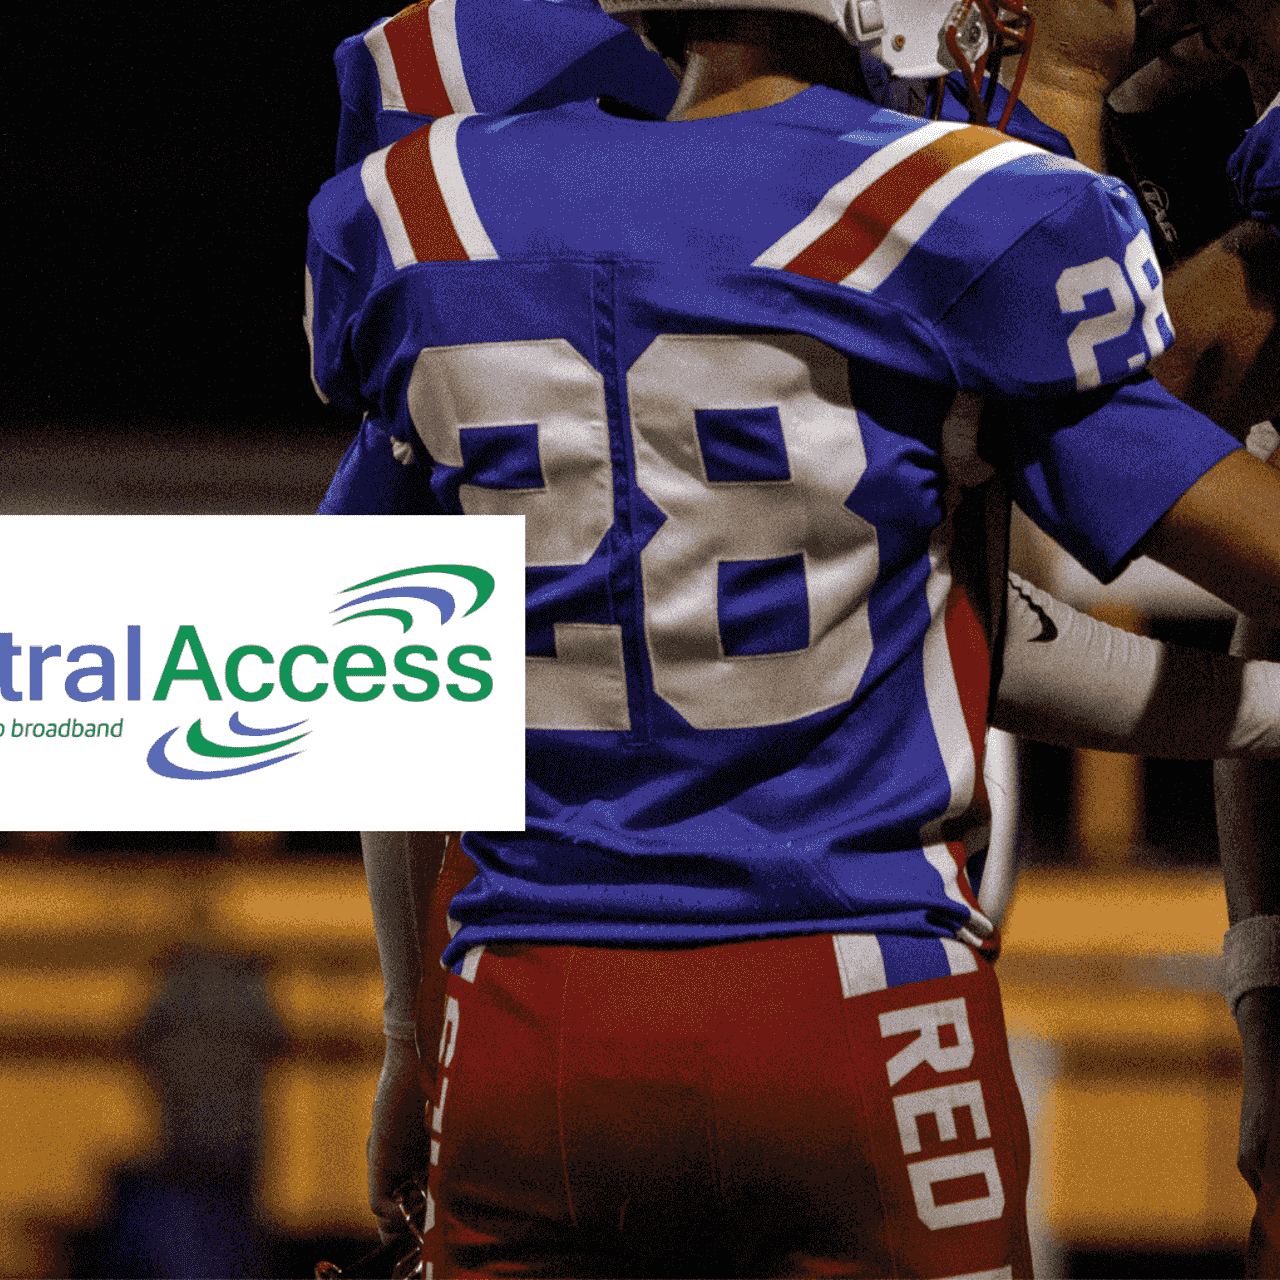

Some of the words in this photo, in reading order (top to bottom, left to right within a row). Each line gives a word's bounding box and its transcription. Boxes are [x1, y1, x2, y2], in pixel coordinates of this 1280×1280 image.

[1055, 228, 1177, 393] 28
[406, 333, 881, 731] 28
[877, 995, 1006, 1232] RED
